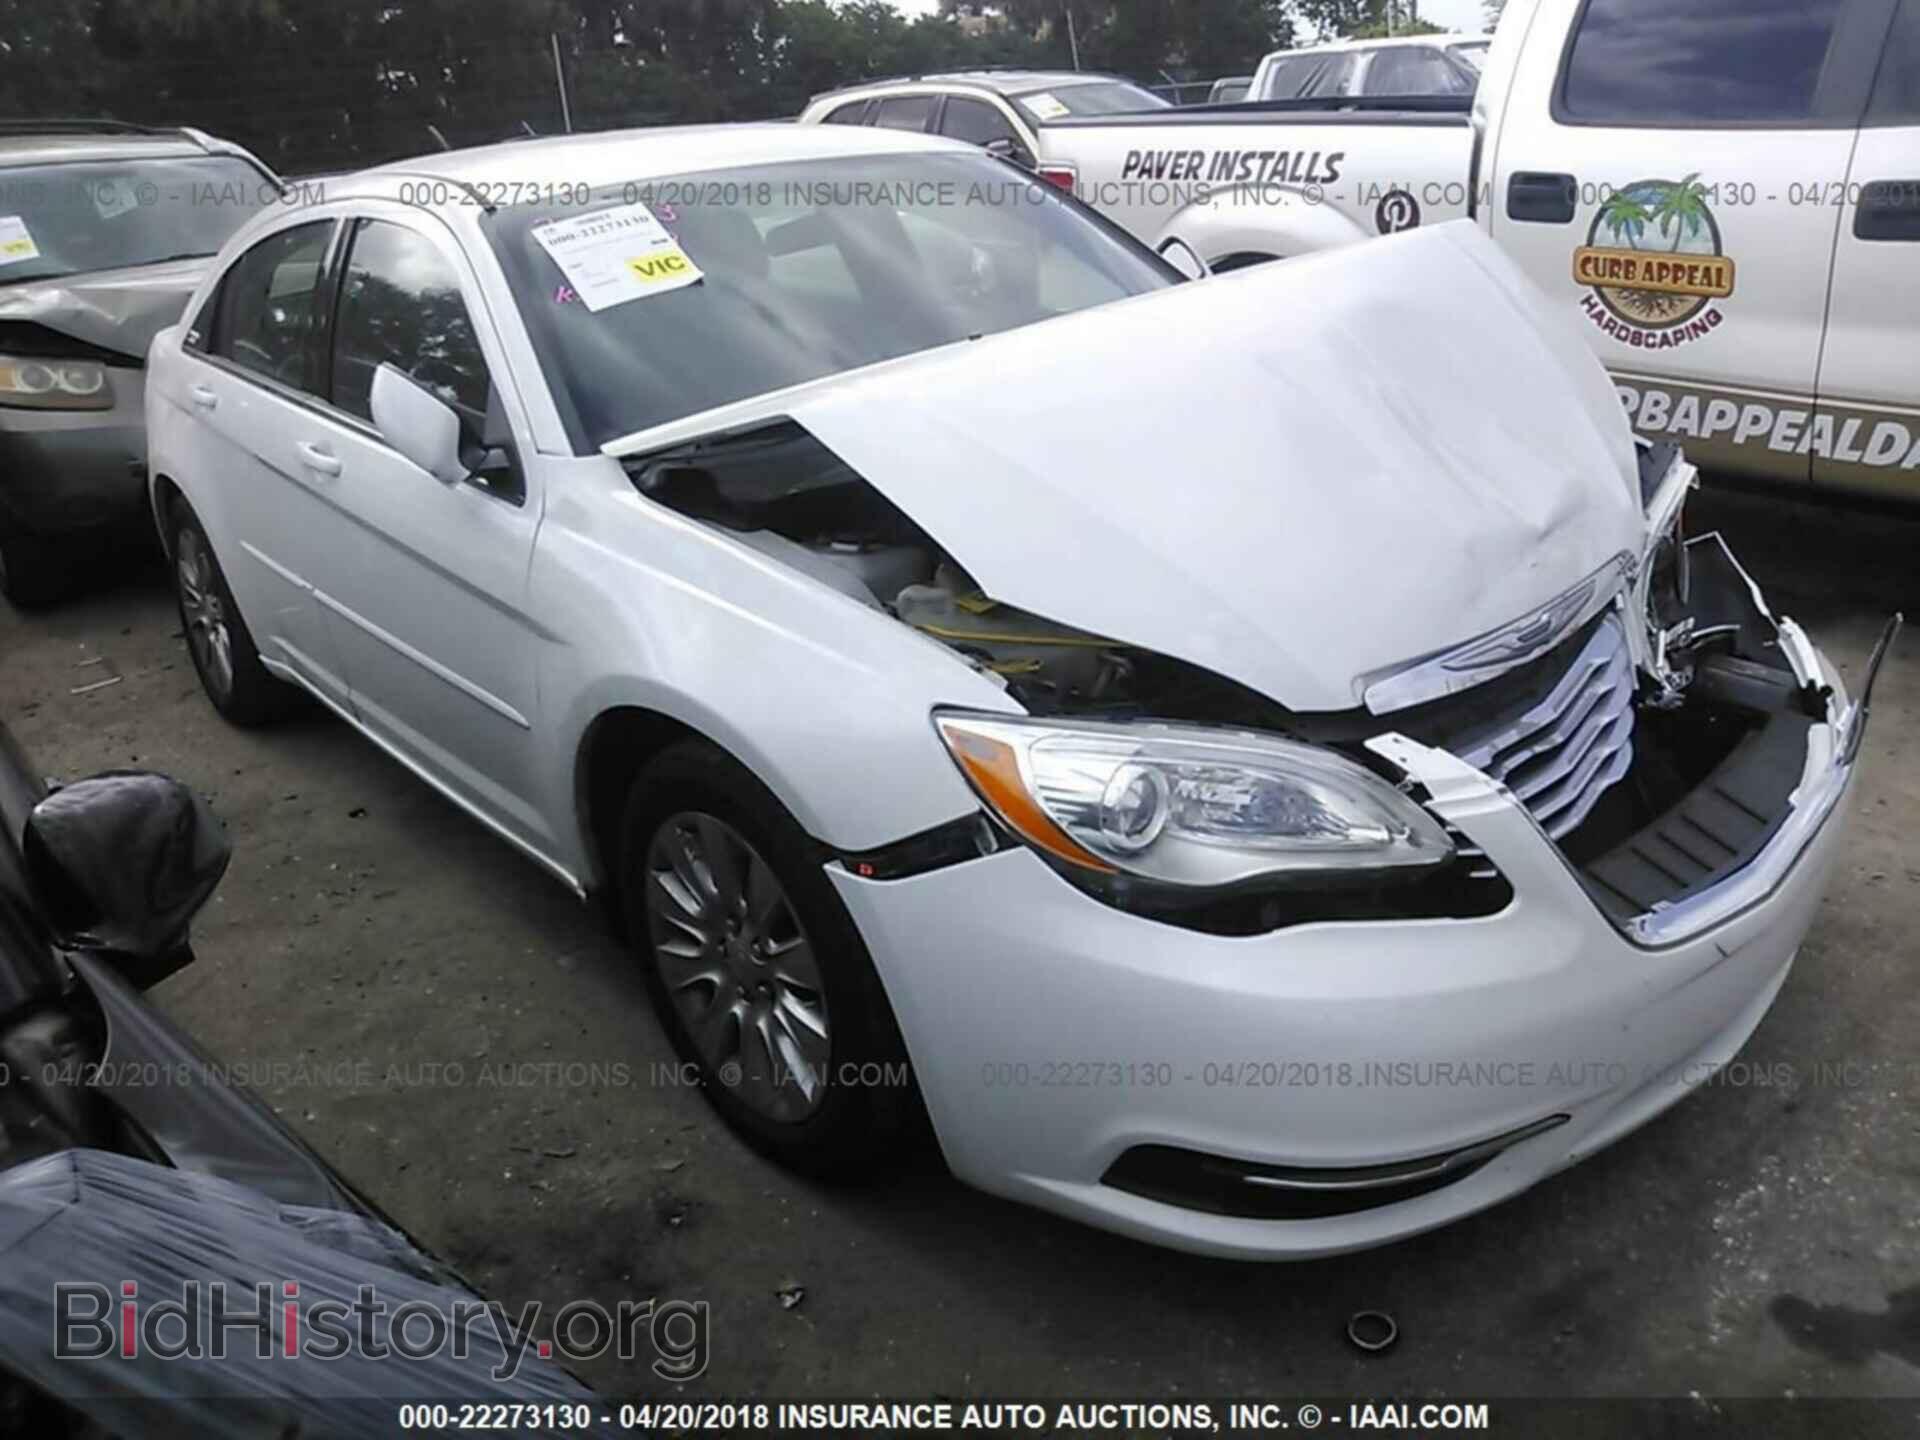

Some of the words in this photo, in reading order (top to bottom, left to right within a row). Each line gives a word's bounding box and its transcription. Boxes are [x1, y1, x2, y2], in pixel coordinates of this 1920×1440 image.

[1122, 150, 1205, 180] PAVER
[1206, 151, 1344, 184] INSTALLS
[633, 255, 685, 277] VIC
[1579, 256, 1636, 281] CURB
[1642, 262, 1727, 289] APPEAL
[1580, 295, 1723, 349] HARDSCAPING
